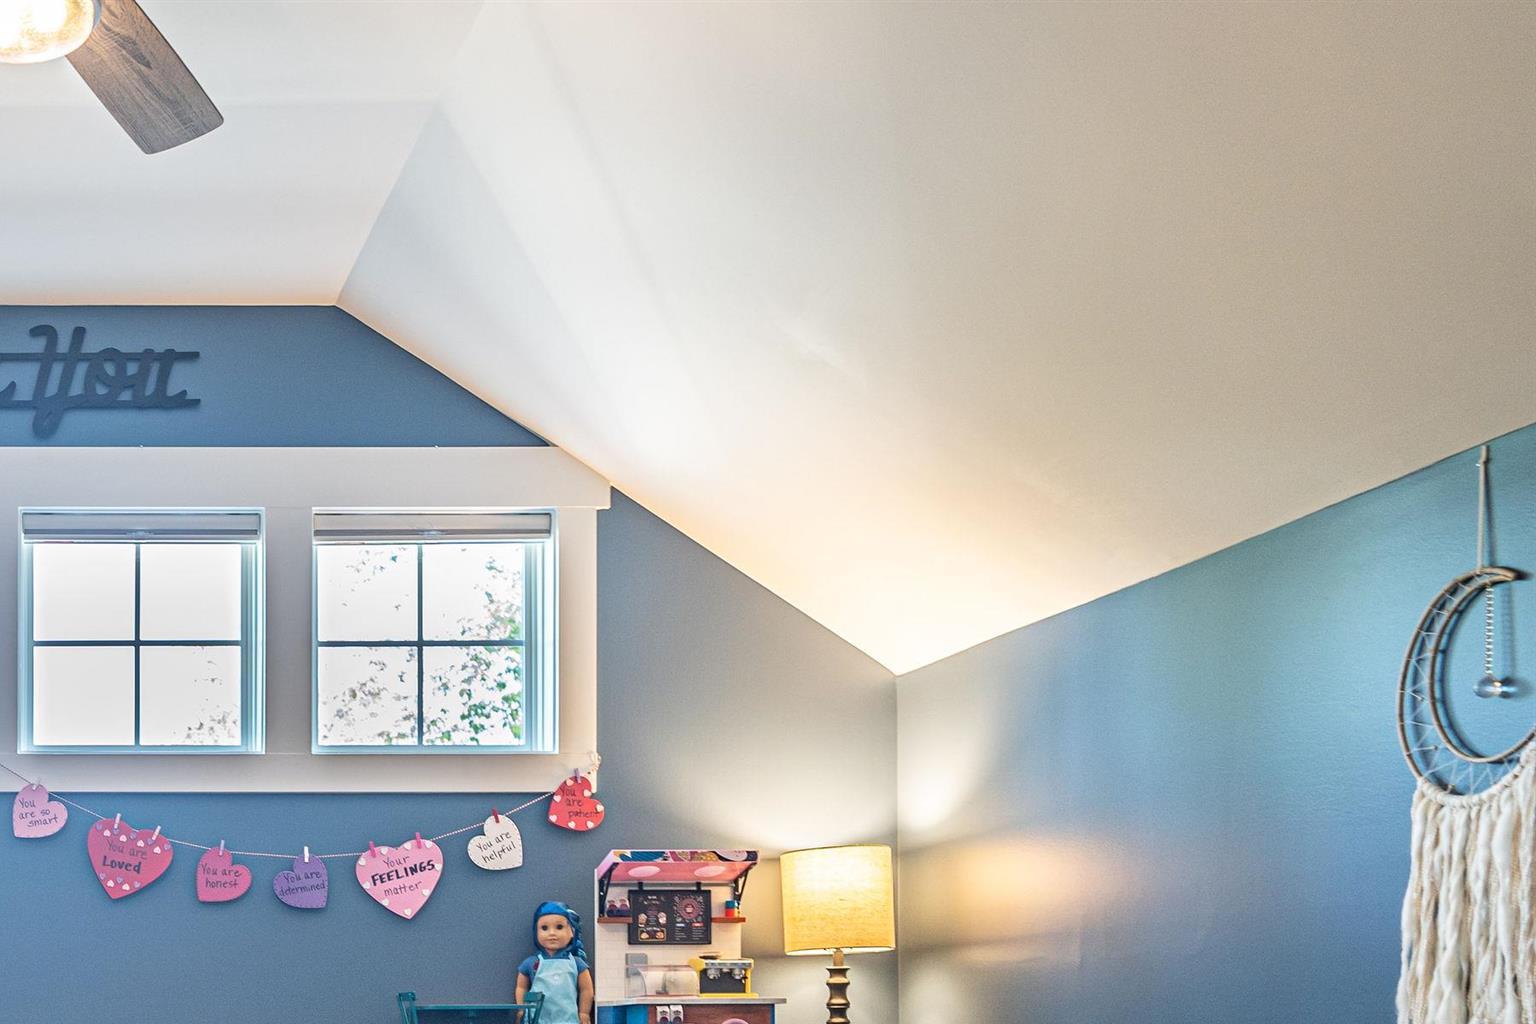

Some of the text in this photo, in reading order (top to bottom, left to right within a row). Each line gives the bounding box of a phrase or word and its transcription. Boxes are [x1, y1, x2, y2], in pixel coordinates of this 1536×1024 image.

[19, 798, 35, 808] You
[19, 812, 35, 820] are
[27, 815, 58, 827] smart
[476, 832, 512, 852] You are
[106, 839, 148, 860] You are
[482, 841, 516, 863] helpful
[102, 856, 142, 874] Loved
[383, 856, 409, 869] Your
[201, 863, 242, 877] You are
[284, 871, 321, 883] You are
[371, 860, 435, 886] FEELINGS
[205, 878, 240, 889] honest
[384, 881, 422, 897] matter
